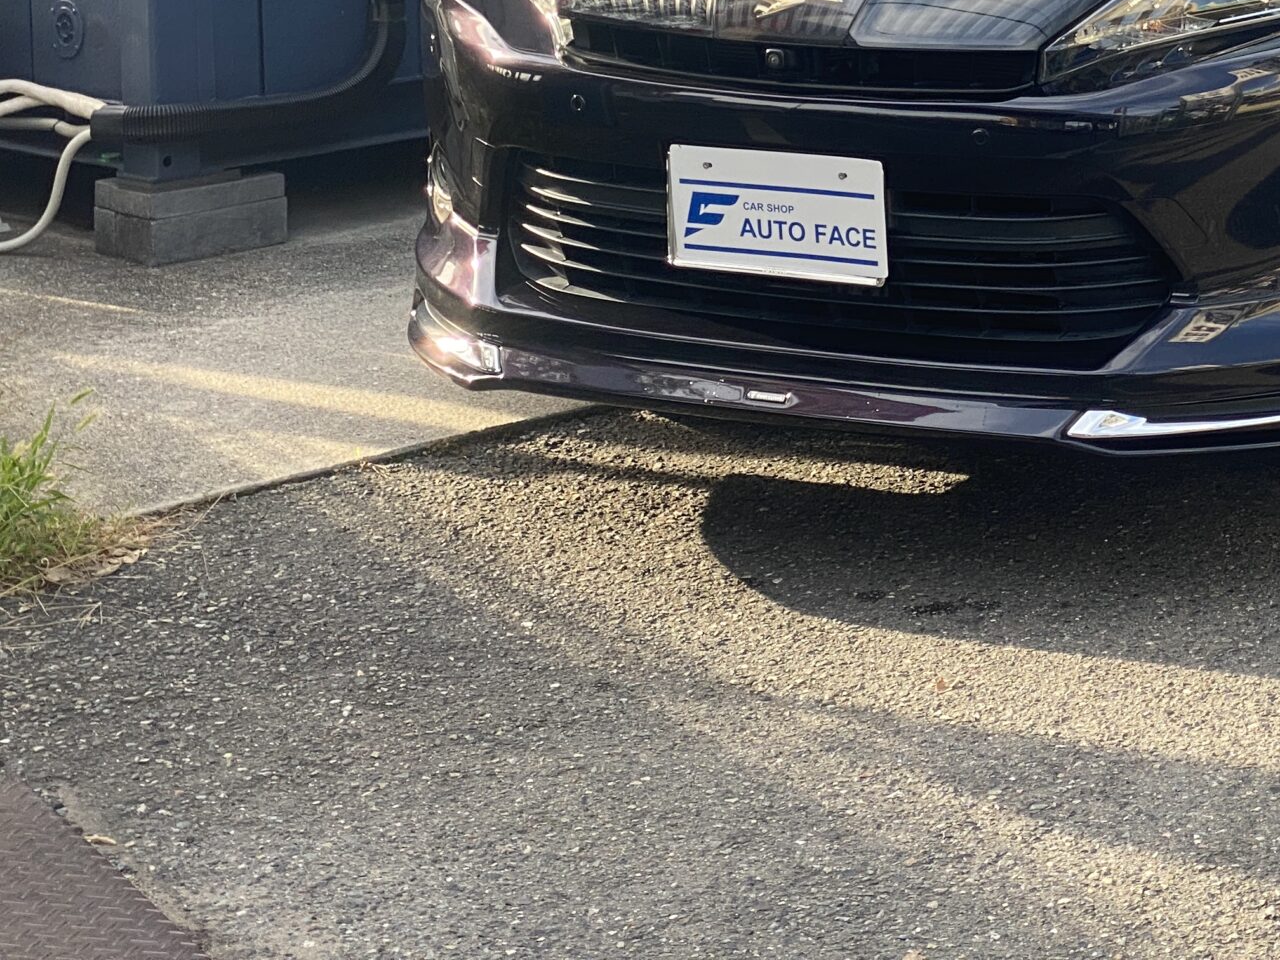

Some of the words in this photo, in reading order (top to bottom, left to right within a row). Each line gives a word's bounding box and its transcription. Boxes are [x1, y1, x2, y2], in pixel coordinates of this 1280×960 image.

[743, 201, 764, 212] CAR
[767, 203, 794, 214] SHOP
[740, 218, 806, 242] AUTO
[815, 224, 877, 249] FACE
